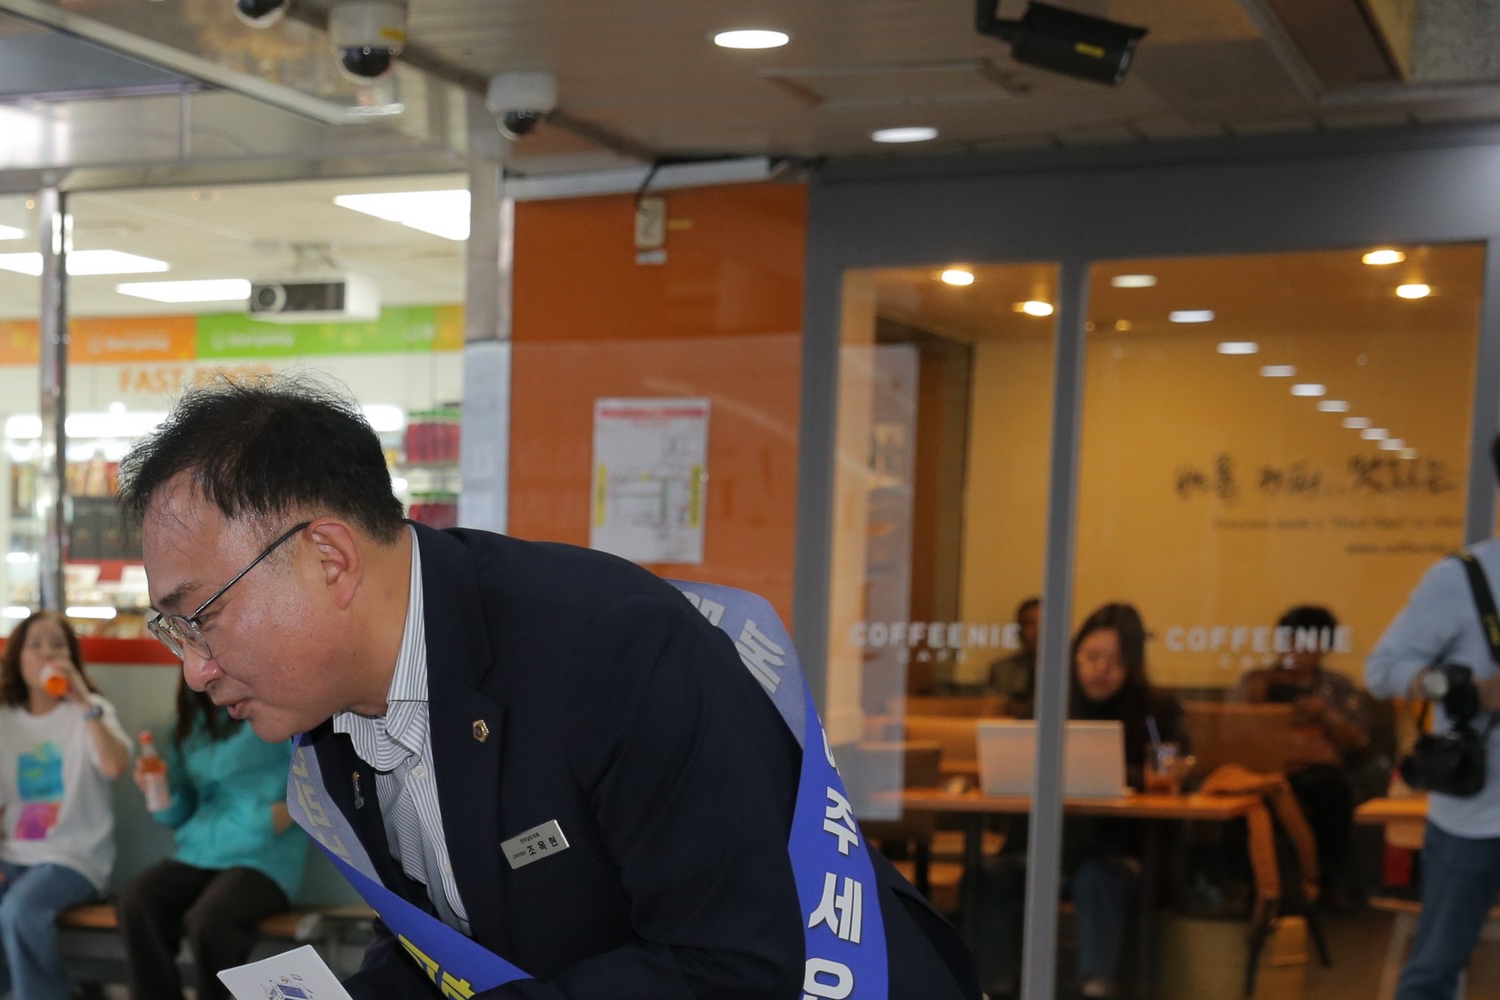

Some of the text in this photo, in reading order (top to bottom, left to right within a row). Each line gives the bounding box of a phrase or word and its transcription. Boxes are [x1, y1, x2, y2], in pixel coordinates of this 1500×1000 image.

[119, 368, 184, 394] FAST
[849, 621, 1022, 649] COFFEENIE
[1164, 624, 1353, 653] COFFEENIE
